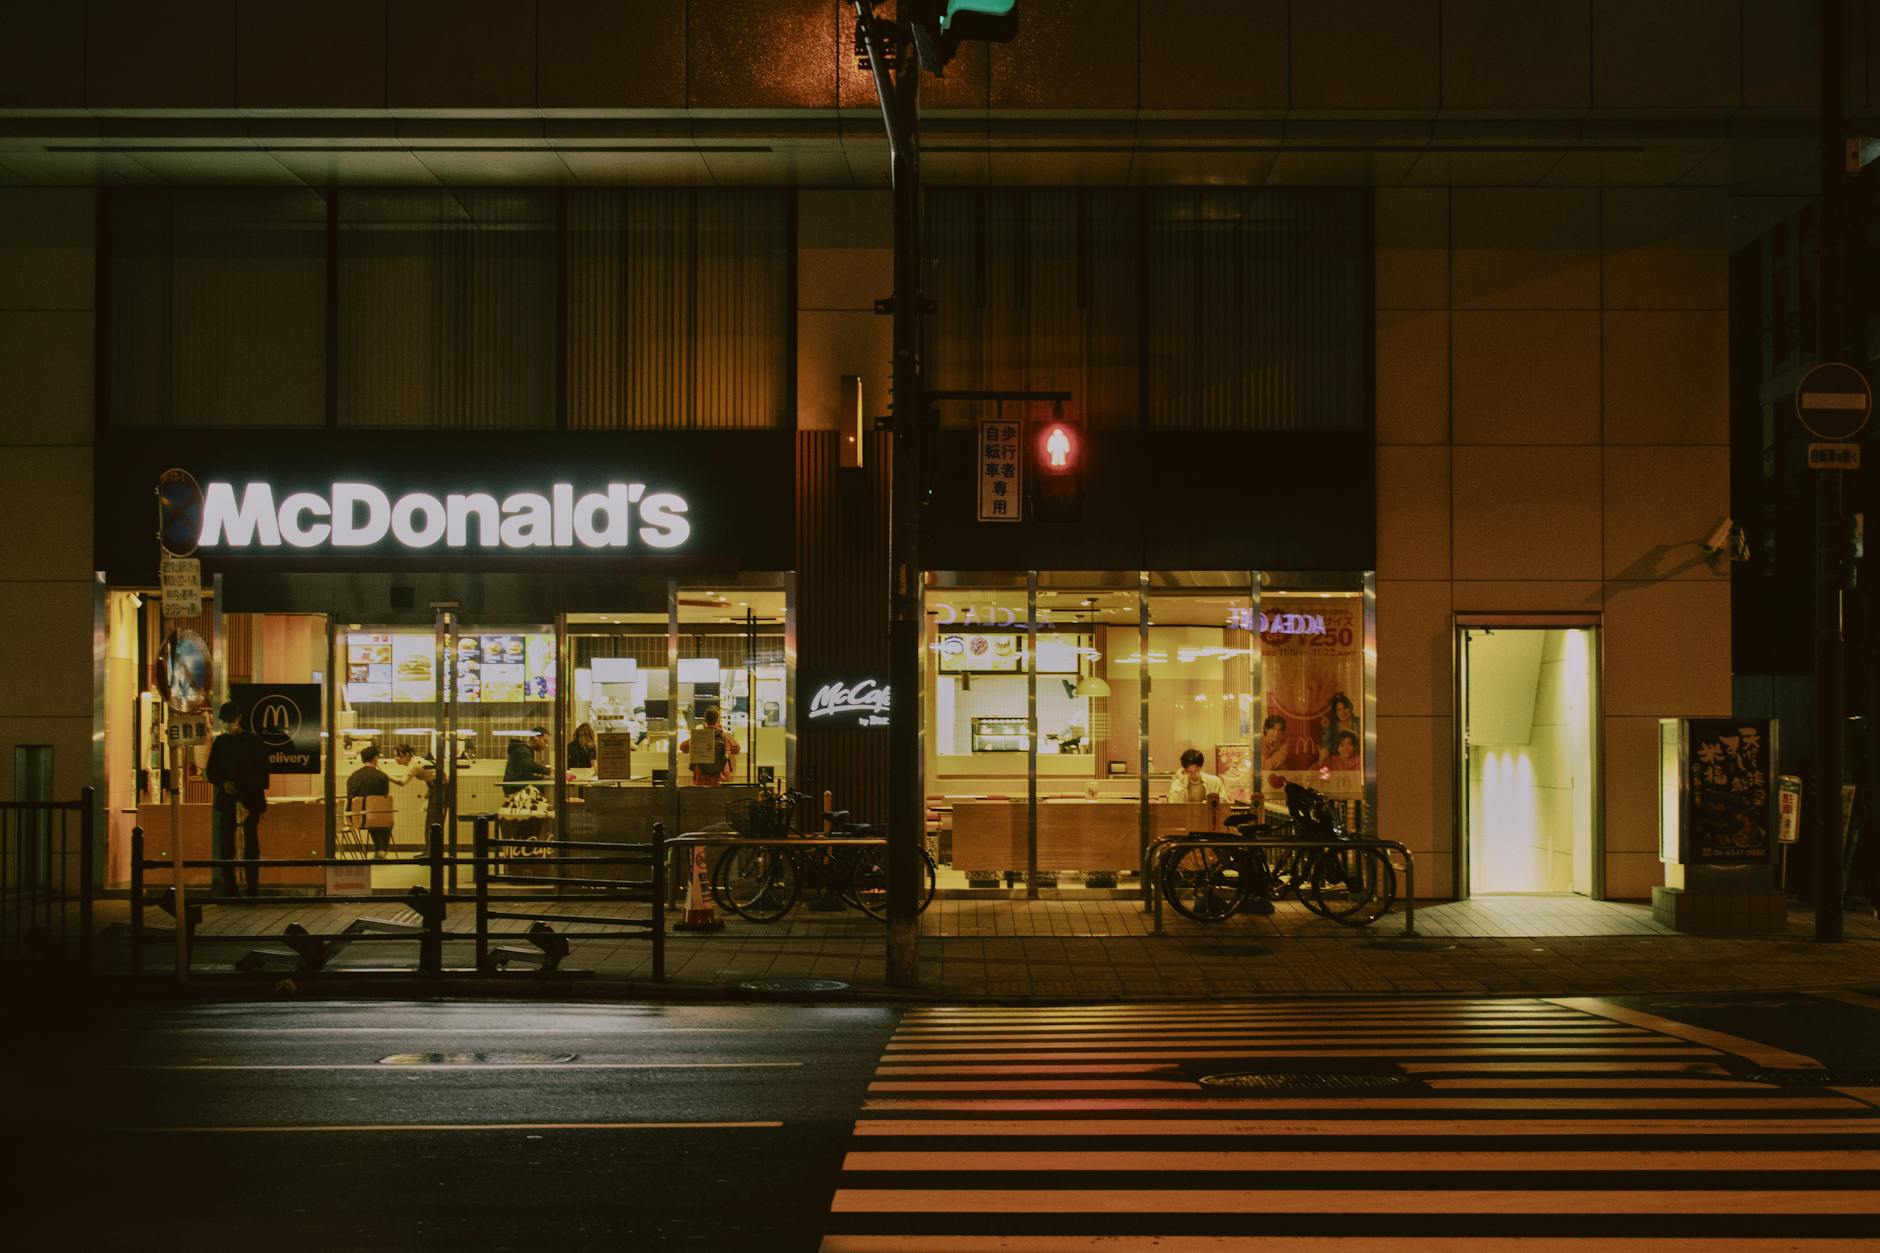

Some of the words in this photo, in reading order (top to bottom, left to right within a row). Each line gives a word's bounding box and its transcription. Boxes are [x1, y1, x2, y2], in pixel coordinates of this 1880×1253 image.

[984, 426, 1000, 478] 自転車
[1000, 426, 1016, 478] 歩行者
[198, 482, 692, 549] McDonald's
[992, 480, 1008, 514] 専用
[268, 752, 311, 767] elivery
